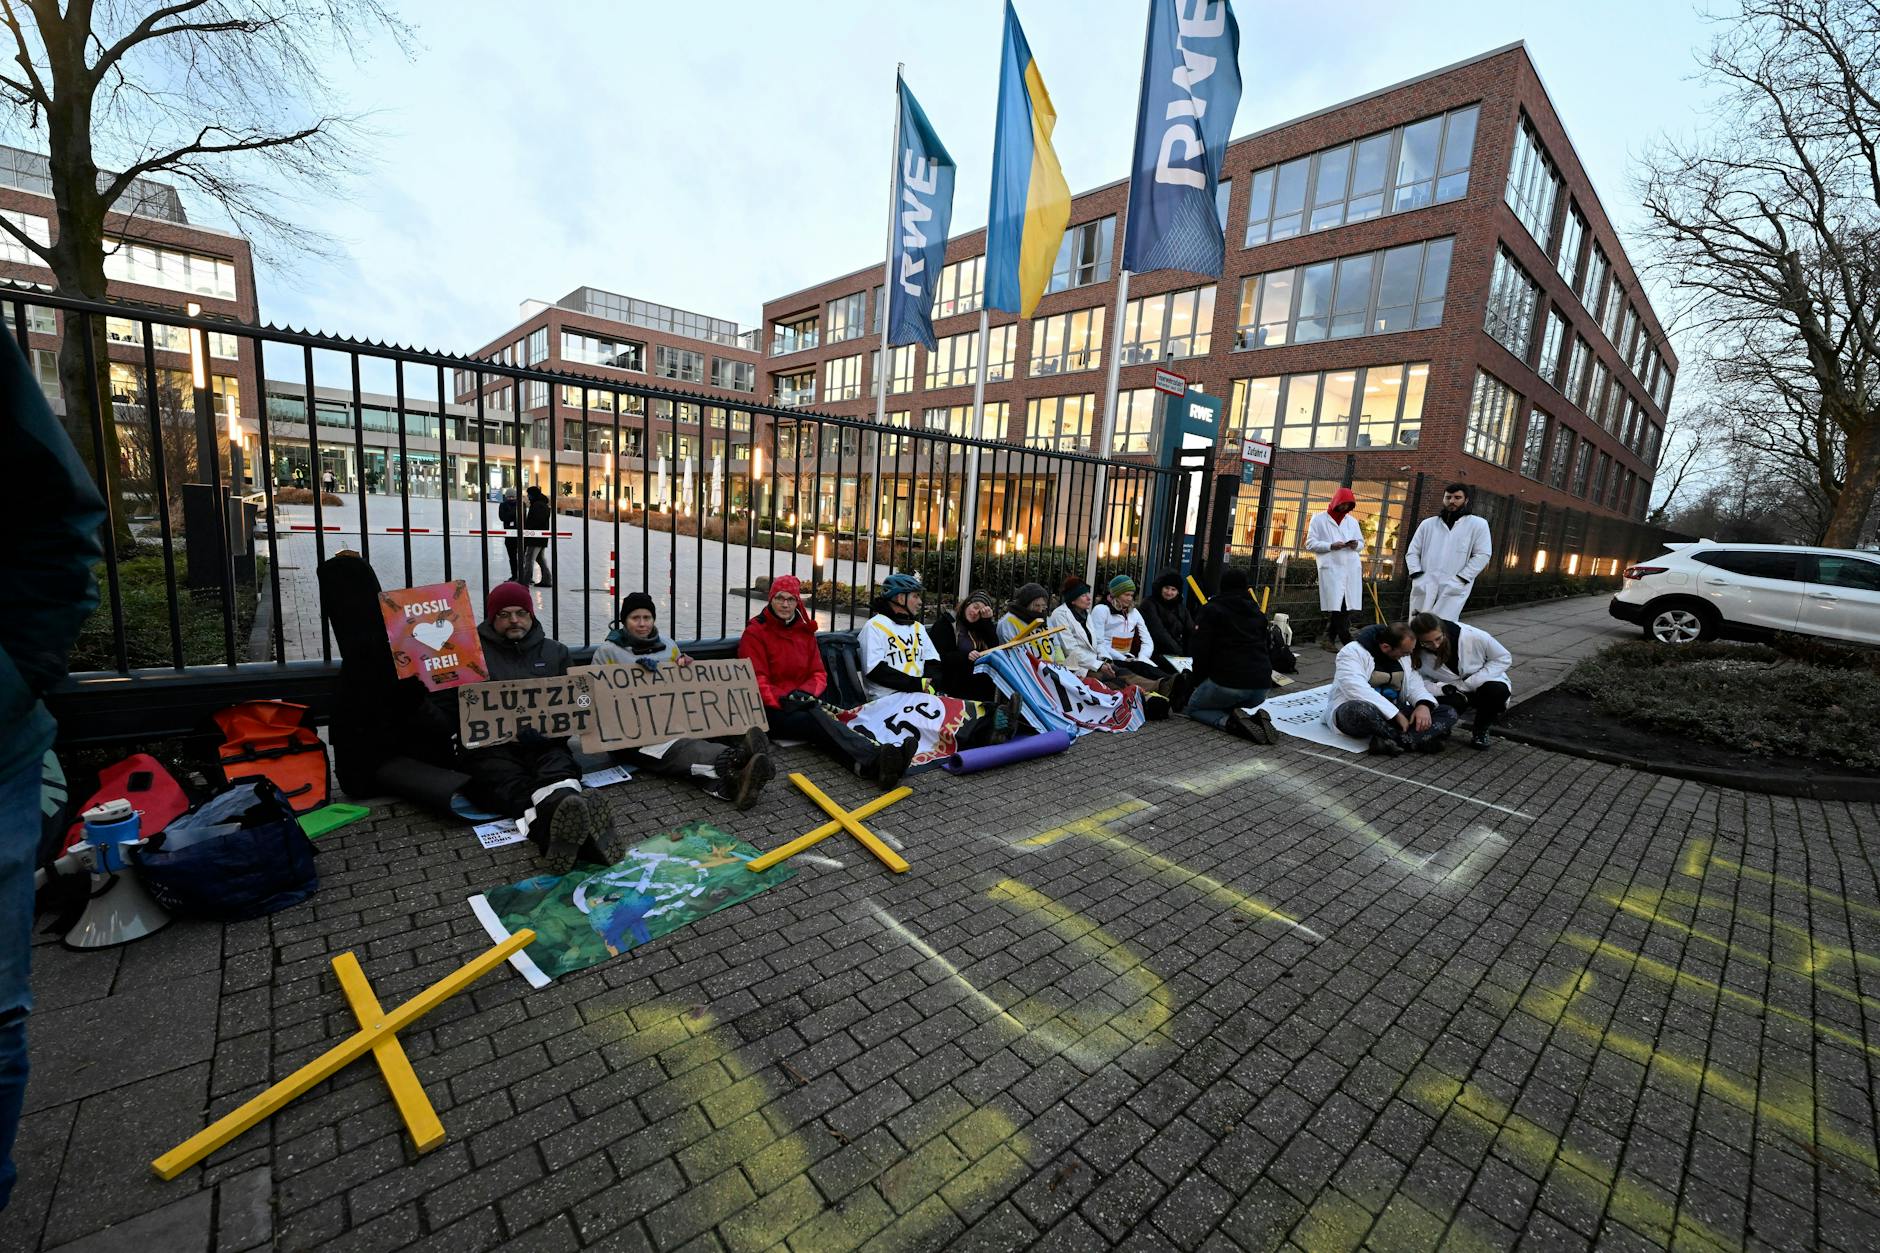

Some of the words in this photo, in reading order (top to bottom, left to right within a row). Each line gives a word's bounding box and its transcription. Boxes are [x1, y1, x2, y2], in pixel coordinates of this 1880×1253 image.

[1155, 0, 1226, 190] RWE
[900, 148, 938, 297] RWE
[1189, 403, 1214, 423] RWE
[1247, 445, 1264, 458] Zufahrt
[404, 599, 451, 617] FOSSIL
[888, 632, 924, 651] RWE
[424, 653, 459, 672] FREI!
[587, 662, 752, 690] MORATORIUM
[481, 680, 576, 712] LÜTZI
[467, 708, 592, 743] BLEIBT
[596, 687, 767, 743] LÜTZERATH
